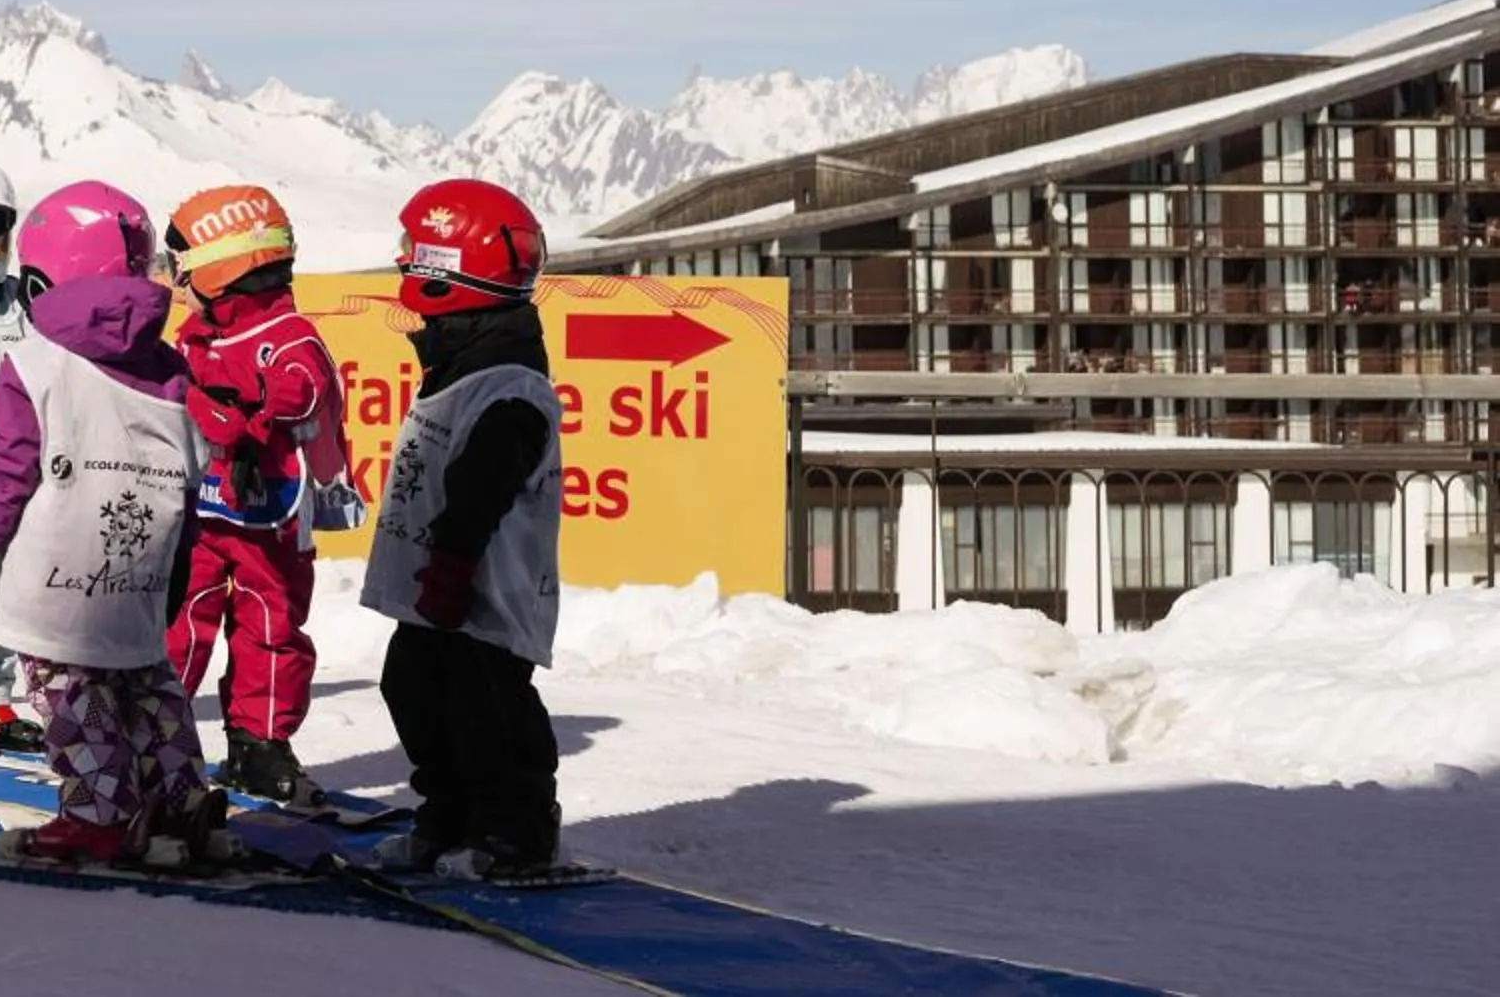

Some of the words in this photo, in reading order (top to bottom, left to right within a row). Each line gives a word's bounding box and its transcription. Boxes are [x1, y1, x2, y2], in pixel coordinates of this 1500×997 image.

[555, 383, 583, 434] e
[609, 370, 709, 439] ski
[84, 460, 120, 471] ECOLE
[345, 439, 392, 504] ki
[46, 566, 83, 590] Les
